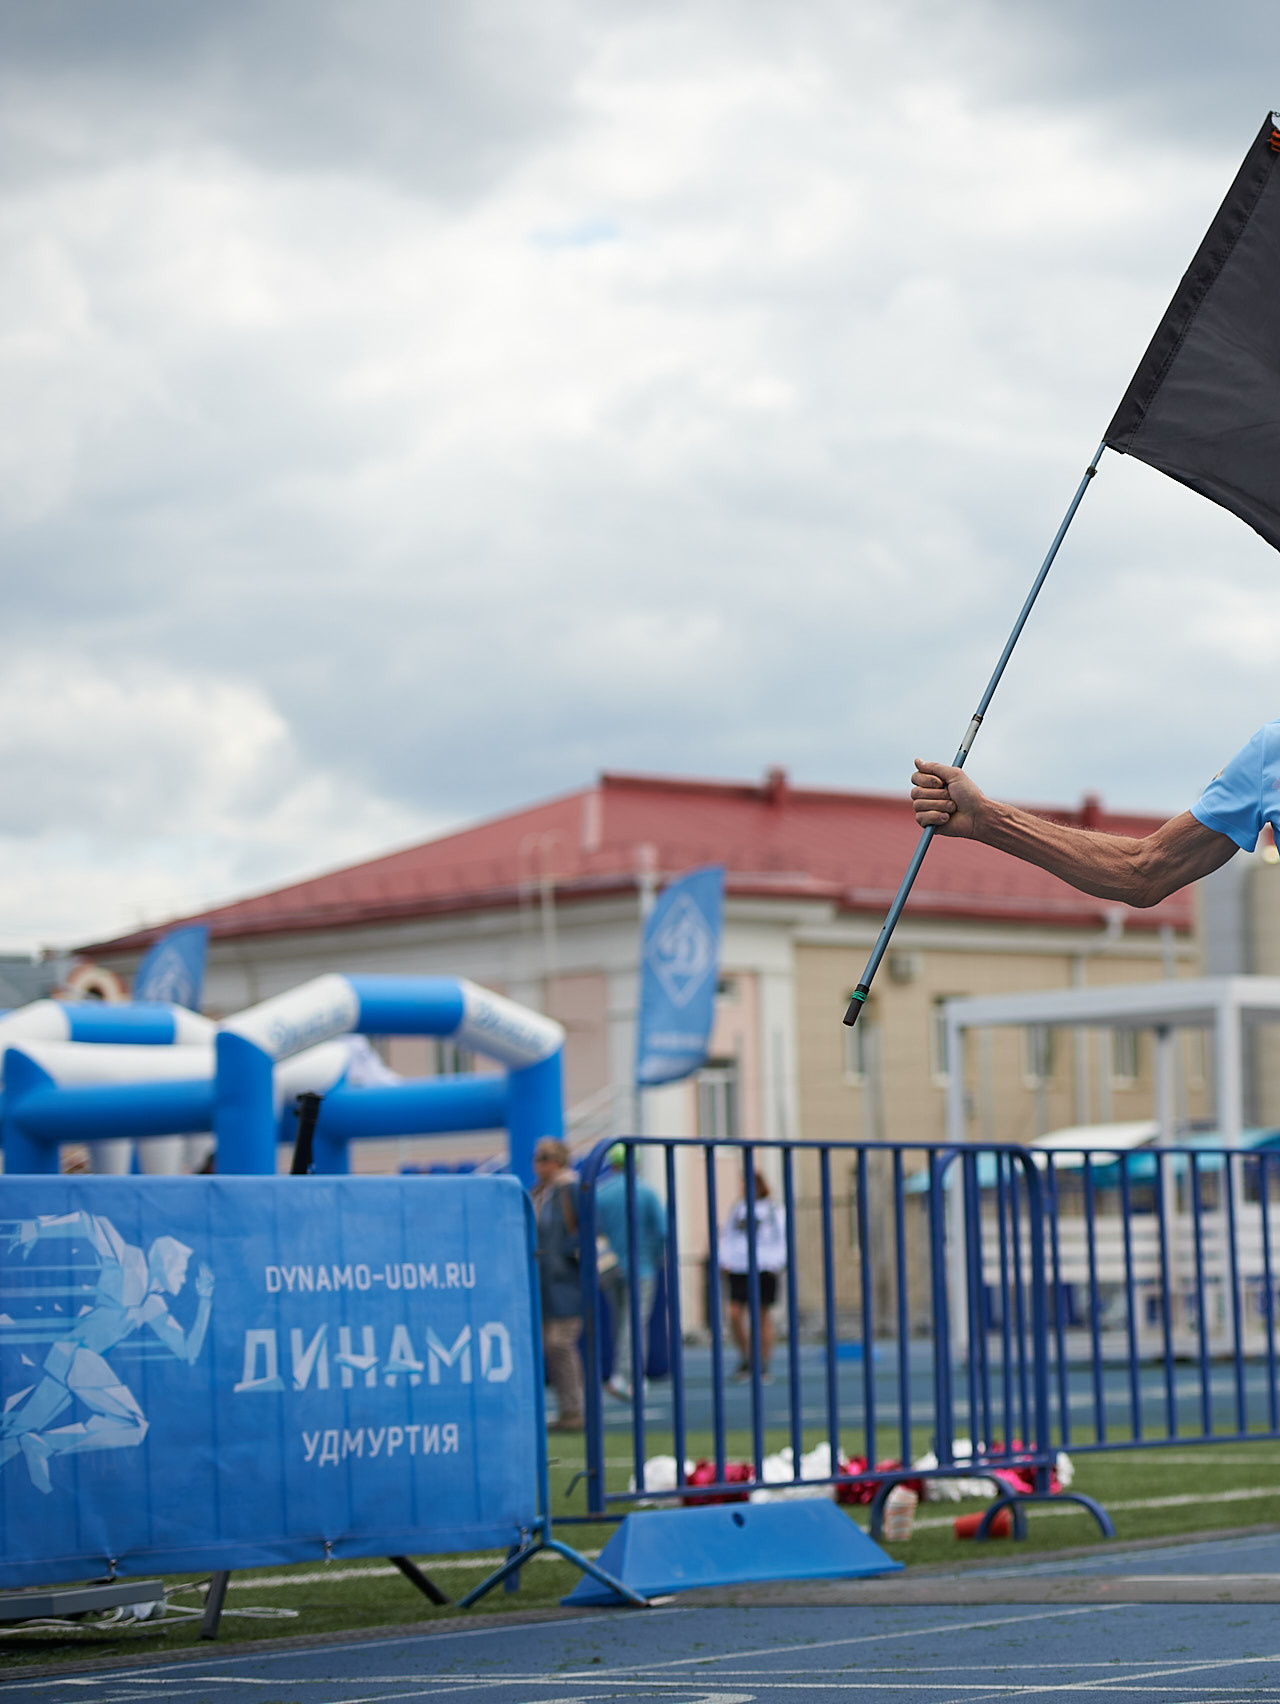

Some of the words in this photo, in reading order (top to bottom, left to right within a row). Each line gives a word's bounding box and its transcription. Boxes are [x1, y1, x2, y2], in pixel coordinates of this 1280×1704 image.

[265, 1262, 476, 1293] DYNAMO-UDM.RU
[233, 1321, 513, 1393] ДИНАМО
[302, 1423, 459, 1467] УДМУРТИЯ
